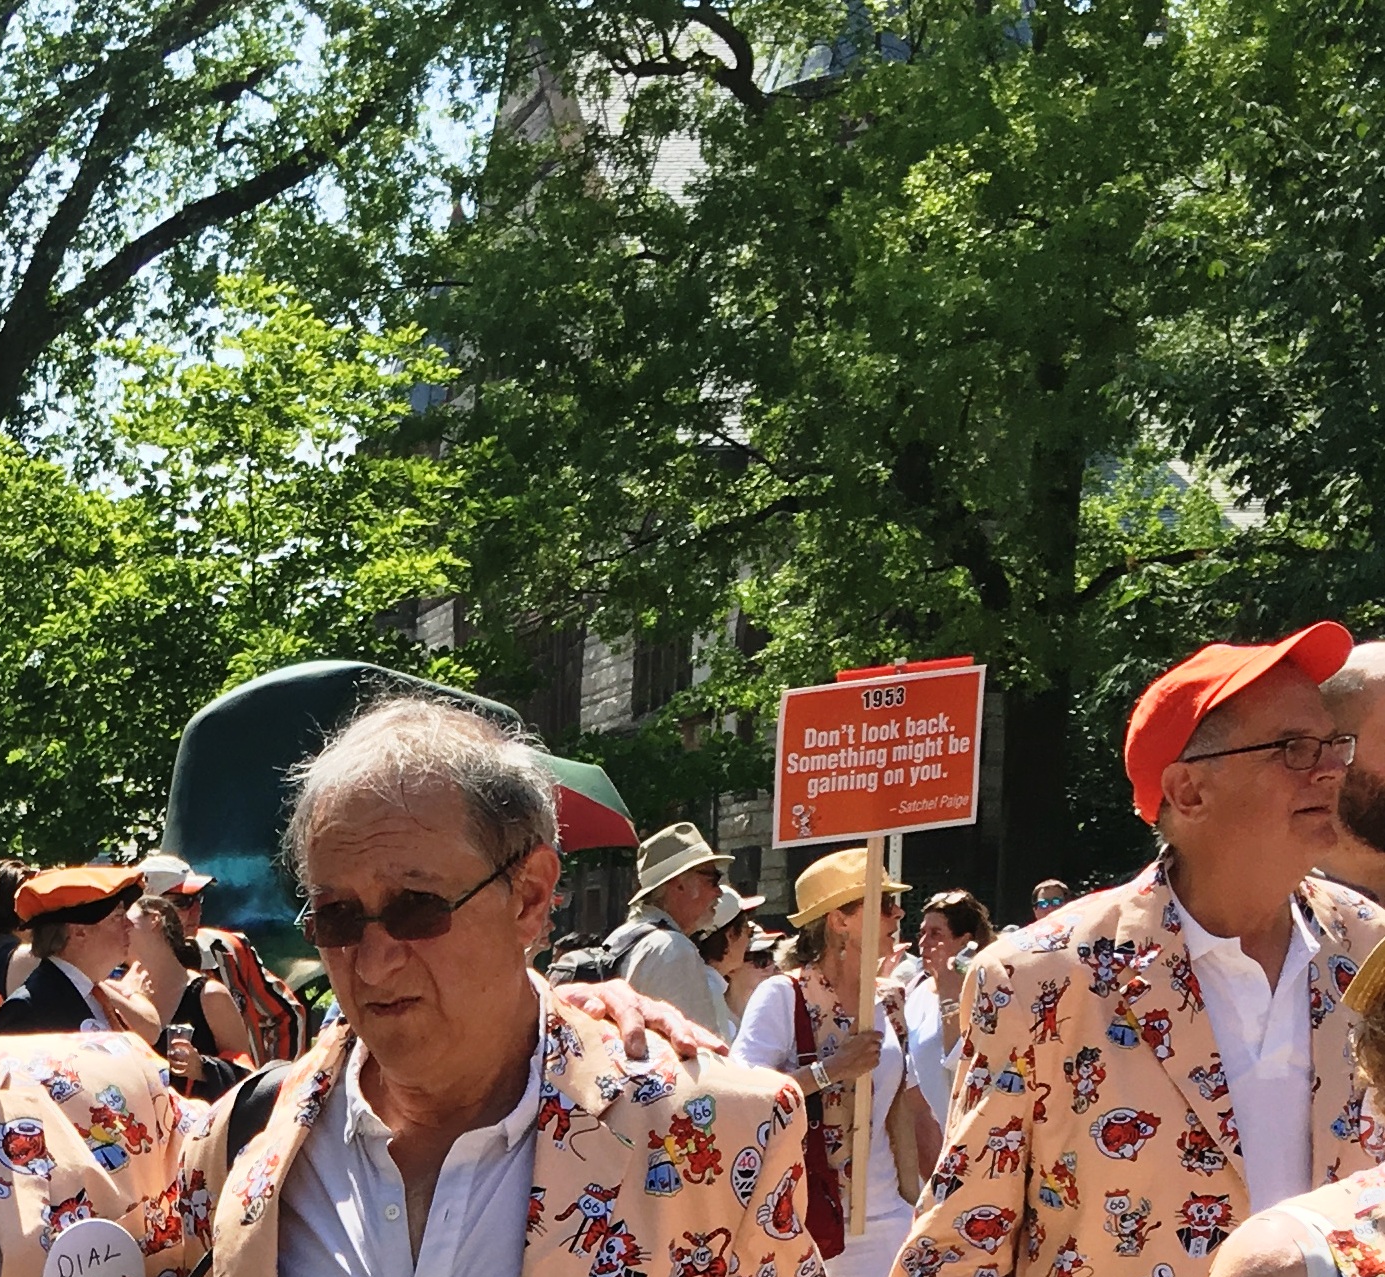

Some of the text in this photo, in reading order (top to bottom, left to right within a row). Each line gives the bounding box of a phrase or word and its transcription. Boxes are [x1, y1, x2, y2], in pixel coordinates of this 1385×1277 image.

[862, 686, 906, 710] 1953
[804, 712, 956, 749] Don't look back.
[787, 733, 970, 774] Something might be
[807, 761, 948, 799] gaining on you.
[939, 794, 970, 810] Paige
[1162, 953, 1180, 969] '66
[649, 1083, 661, 1094] 50
[109, 1093, 121, 1106] 66
[693, 1106, 712, 1121] 66
[991, 1138, 1003, 1147] 66
[738, 1155, 757, 1169] 40
[582, 1199, 601, 1214] 66
[1110, 1200, 1125, 1210] 66
[762, 1267, 775, 1277] 66
